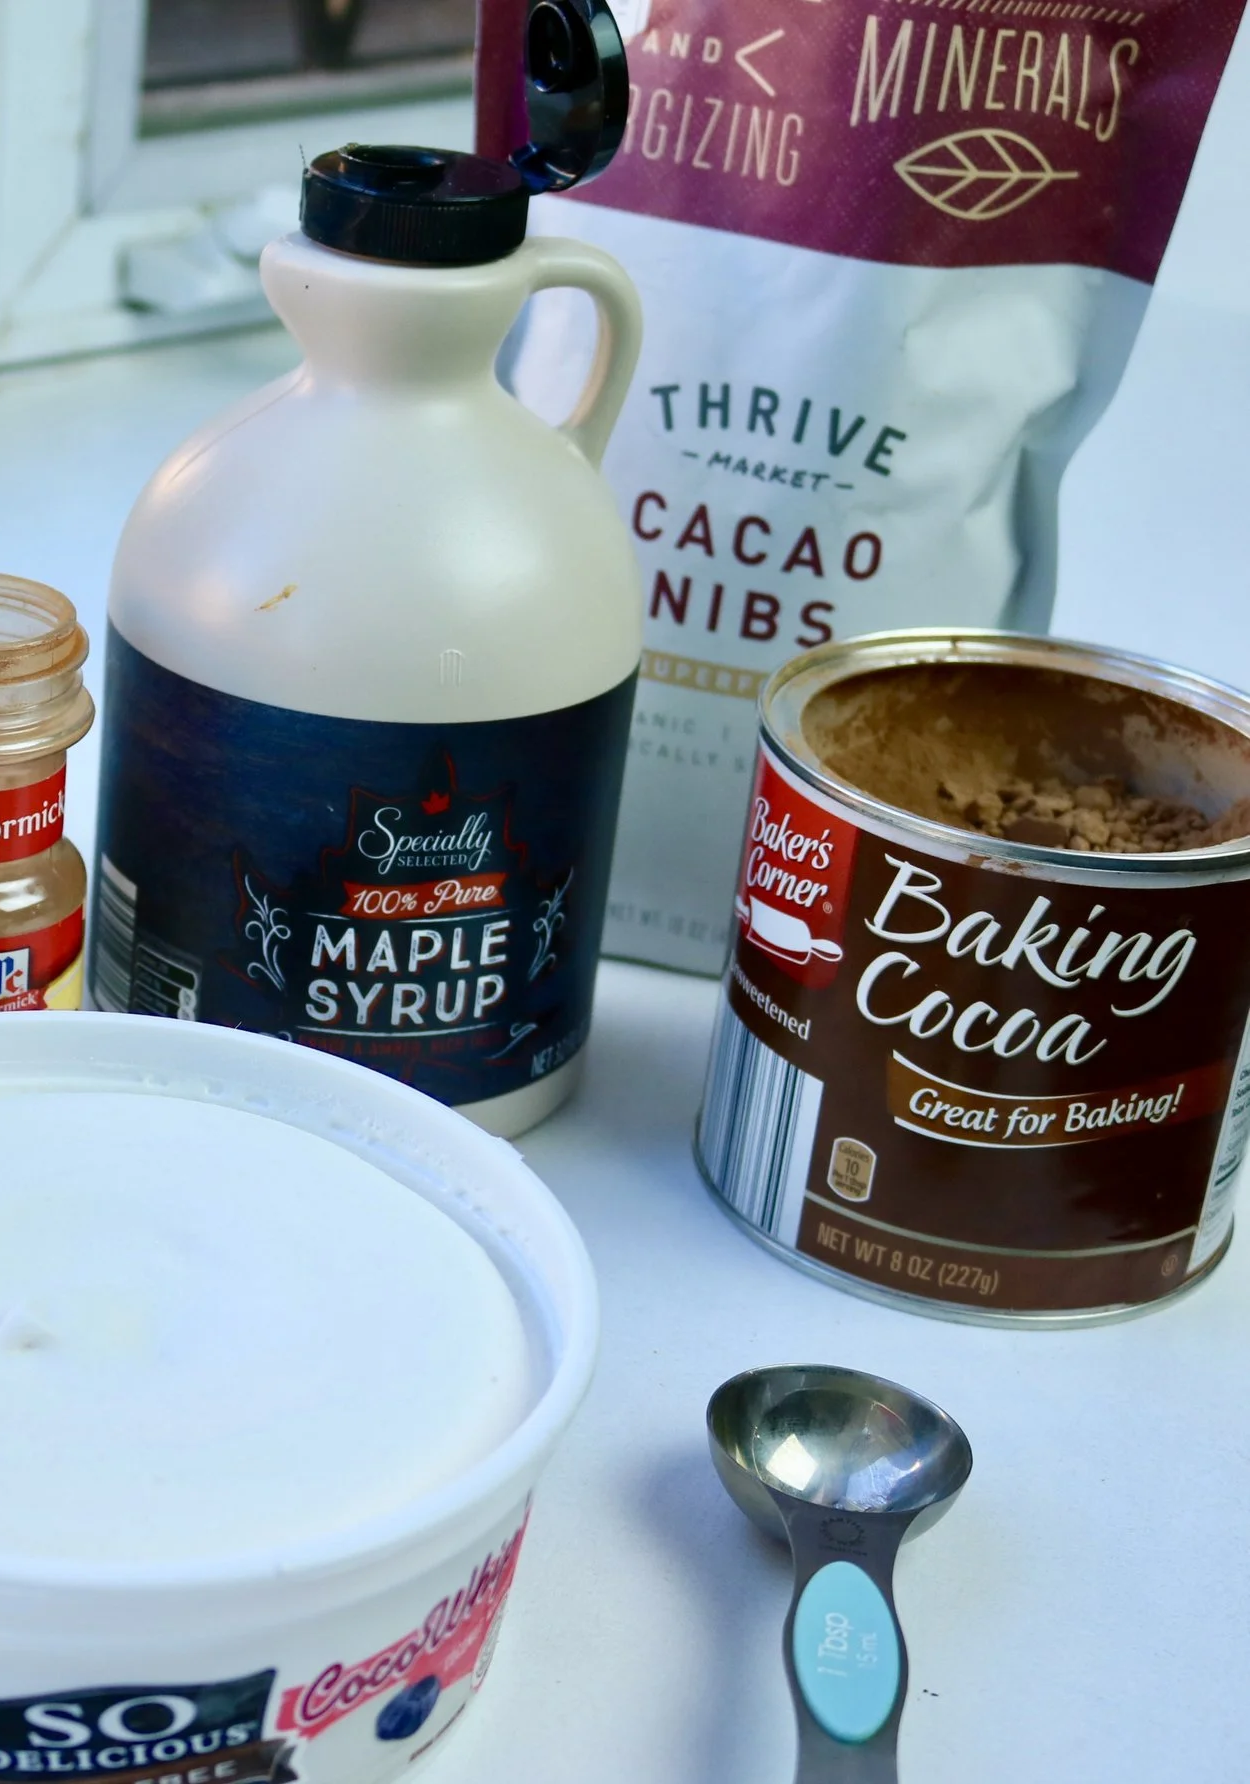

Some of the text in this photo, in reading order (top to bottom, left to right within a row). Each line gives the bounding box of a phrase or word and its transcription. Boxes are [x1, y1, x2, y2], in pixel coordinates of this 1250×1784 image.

[641, 29, 722, 64] AND
[850, 15, 1140, 142] MINERALS
[624, 83, 804, 187] RGIZING
[651, 382, 907, 477] THRIVE
[707, 450, 831, 493] MARKET
[632, 490, 883, 581] CACAO
[649, 569, 835, 649] NIBS
[357, 806, 493, 875] Specially
[397, 854, 468, 868] SELECTED
[750, 797, 834, 870] Baker's
[352, 879, 499, 915] 100% Pure
[309, 919, 512, 975] MAPLE
[864, 853, 1198, 1018] Baking
[305, 974, 507, 1027] SYRUP
[856, 951, 1108, 1067] Cocoa
[909, 1083, 1185, 1140] Great for Baking!
[845, 1158, 861, 1177] 10
[817, 1222, 1000, 1295] NET WT 8 OZ (227g)
[817, 1611, 855, 1660] Tbsp
[24, 1694, 198, 1749] SO
